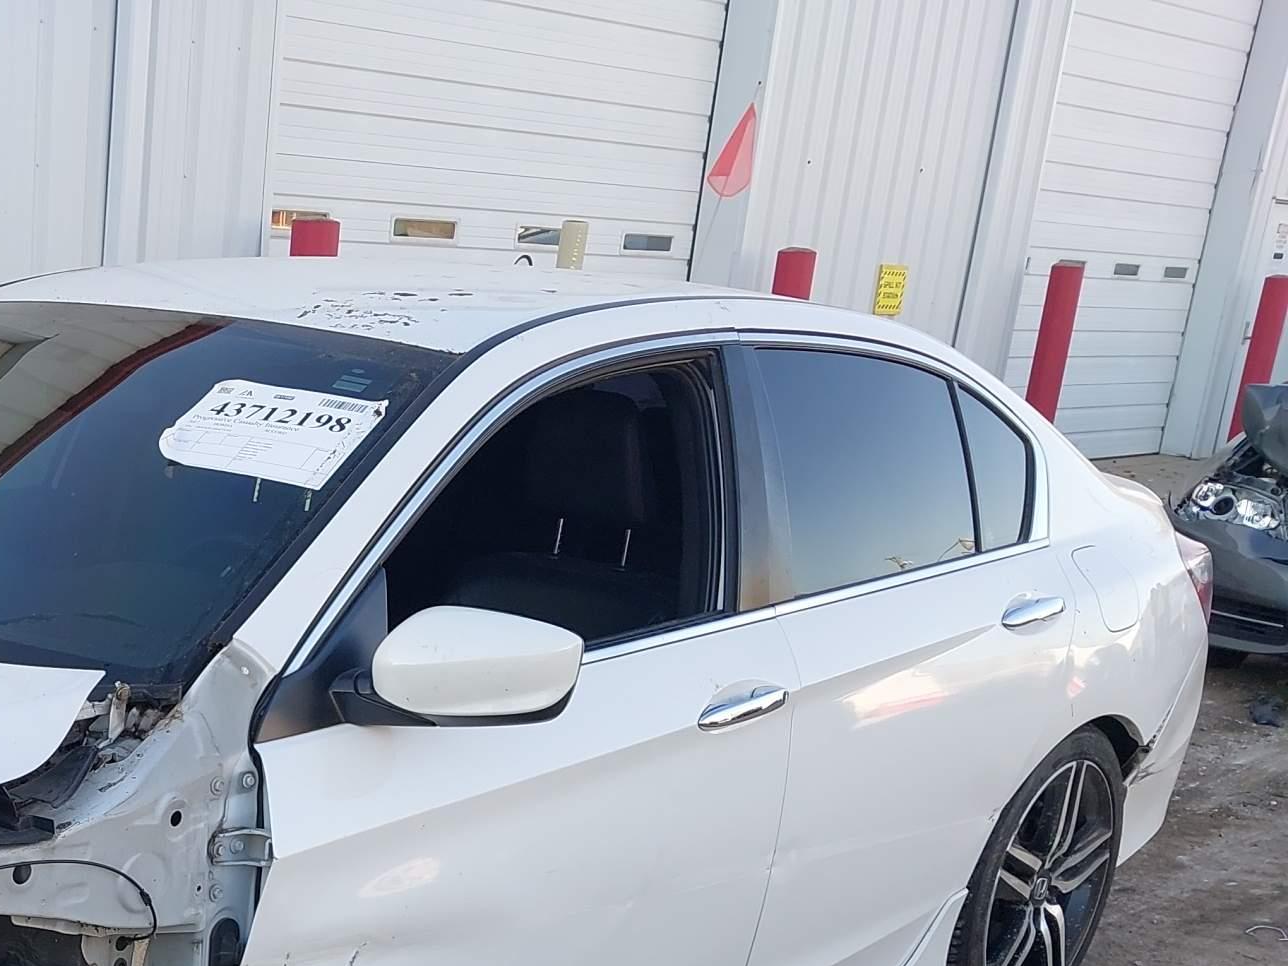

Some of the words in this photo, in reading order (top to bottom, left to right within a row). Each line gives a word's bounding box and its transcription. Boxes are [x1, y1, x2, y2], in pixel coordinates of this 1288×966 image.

[192, 413, 233, 424] Progressive
[233, 417, 262, 428] Casualty
[264, 422, 300, 432] Insurance
[209, 400, 352, 433] 43712198
